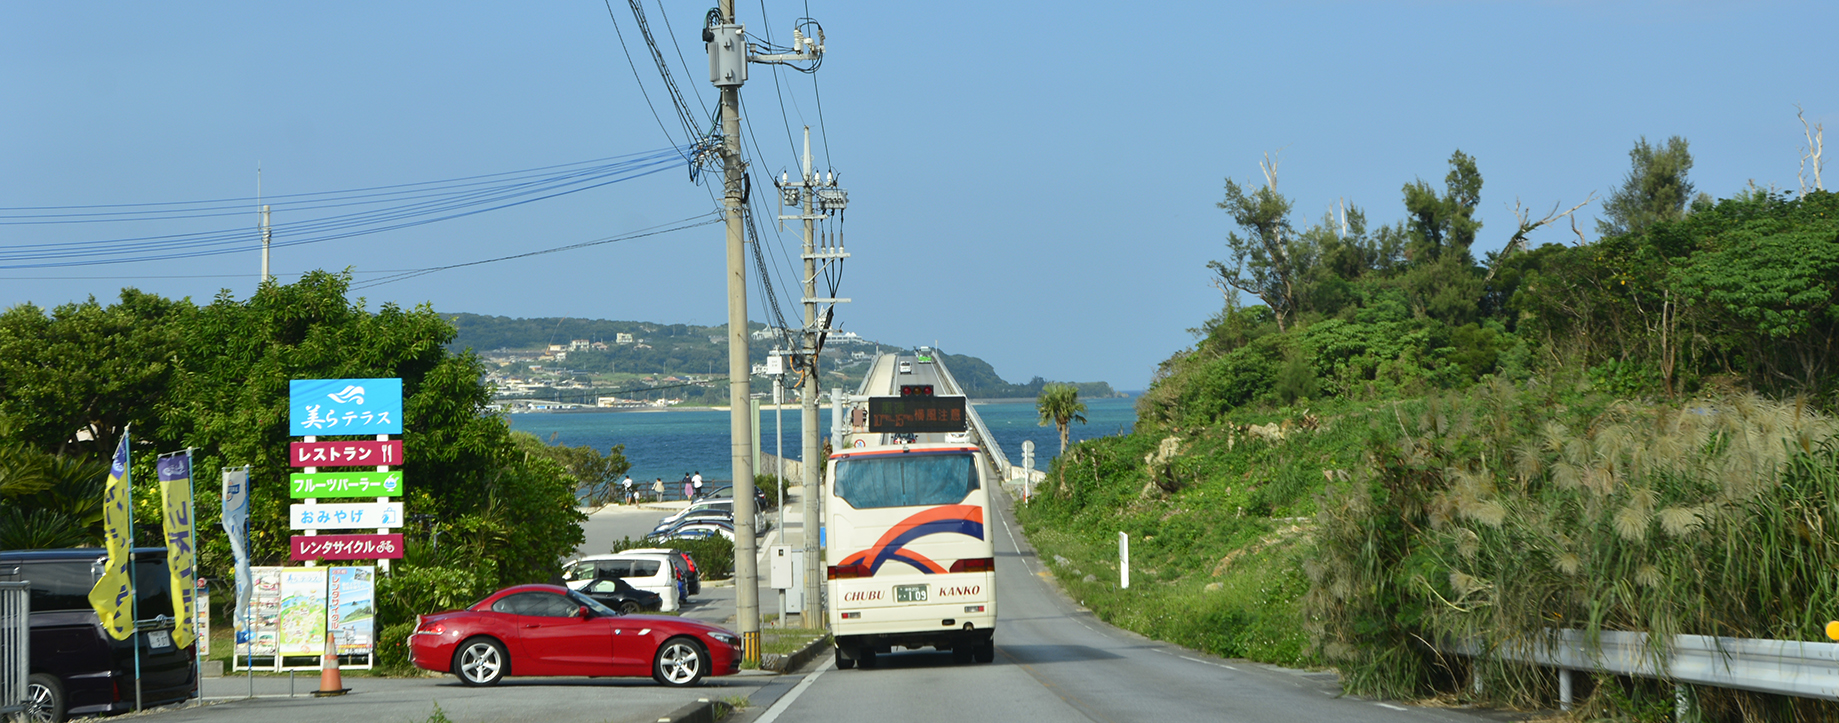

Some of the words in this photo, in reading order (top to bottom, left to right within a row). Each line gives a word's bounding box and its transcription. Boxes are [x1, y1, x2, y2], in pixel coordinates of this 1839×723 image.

[300, 404, 391, 429] 美らテラス
[914, 408, 961, 421] 横風注意
[298, 446, 372, 461] レストラン
[293, 477, 381, 492] フルーツパーラー
[300, 509, 364, 523] おみやげ
[300, 540, 375, 554] レンタサイクル
[844, 590, 885, 602] CHUBU
[939, 585, 980, 597] KANKO
[331, 576, 340, 629] レンタサイクル
